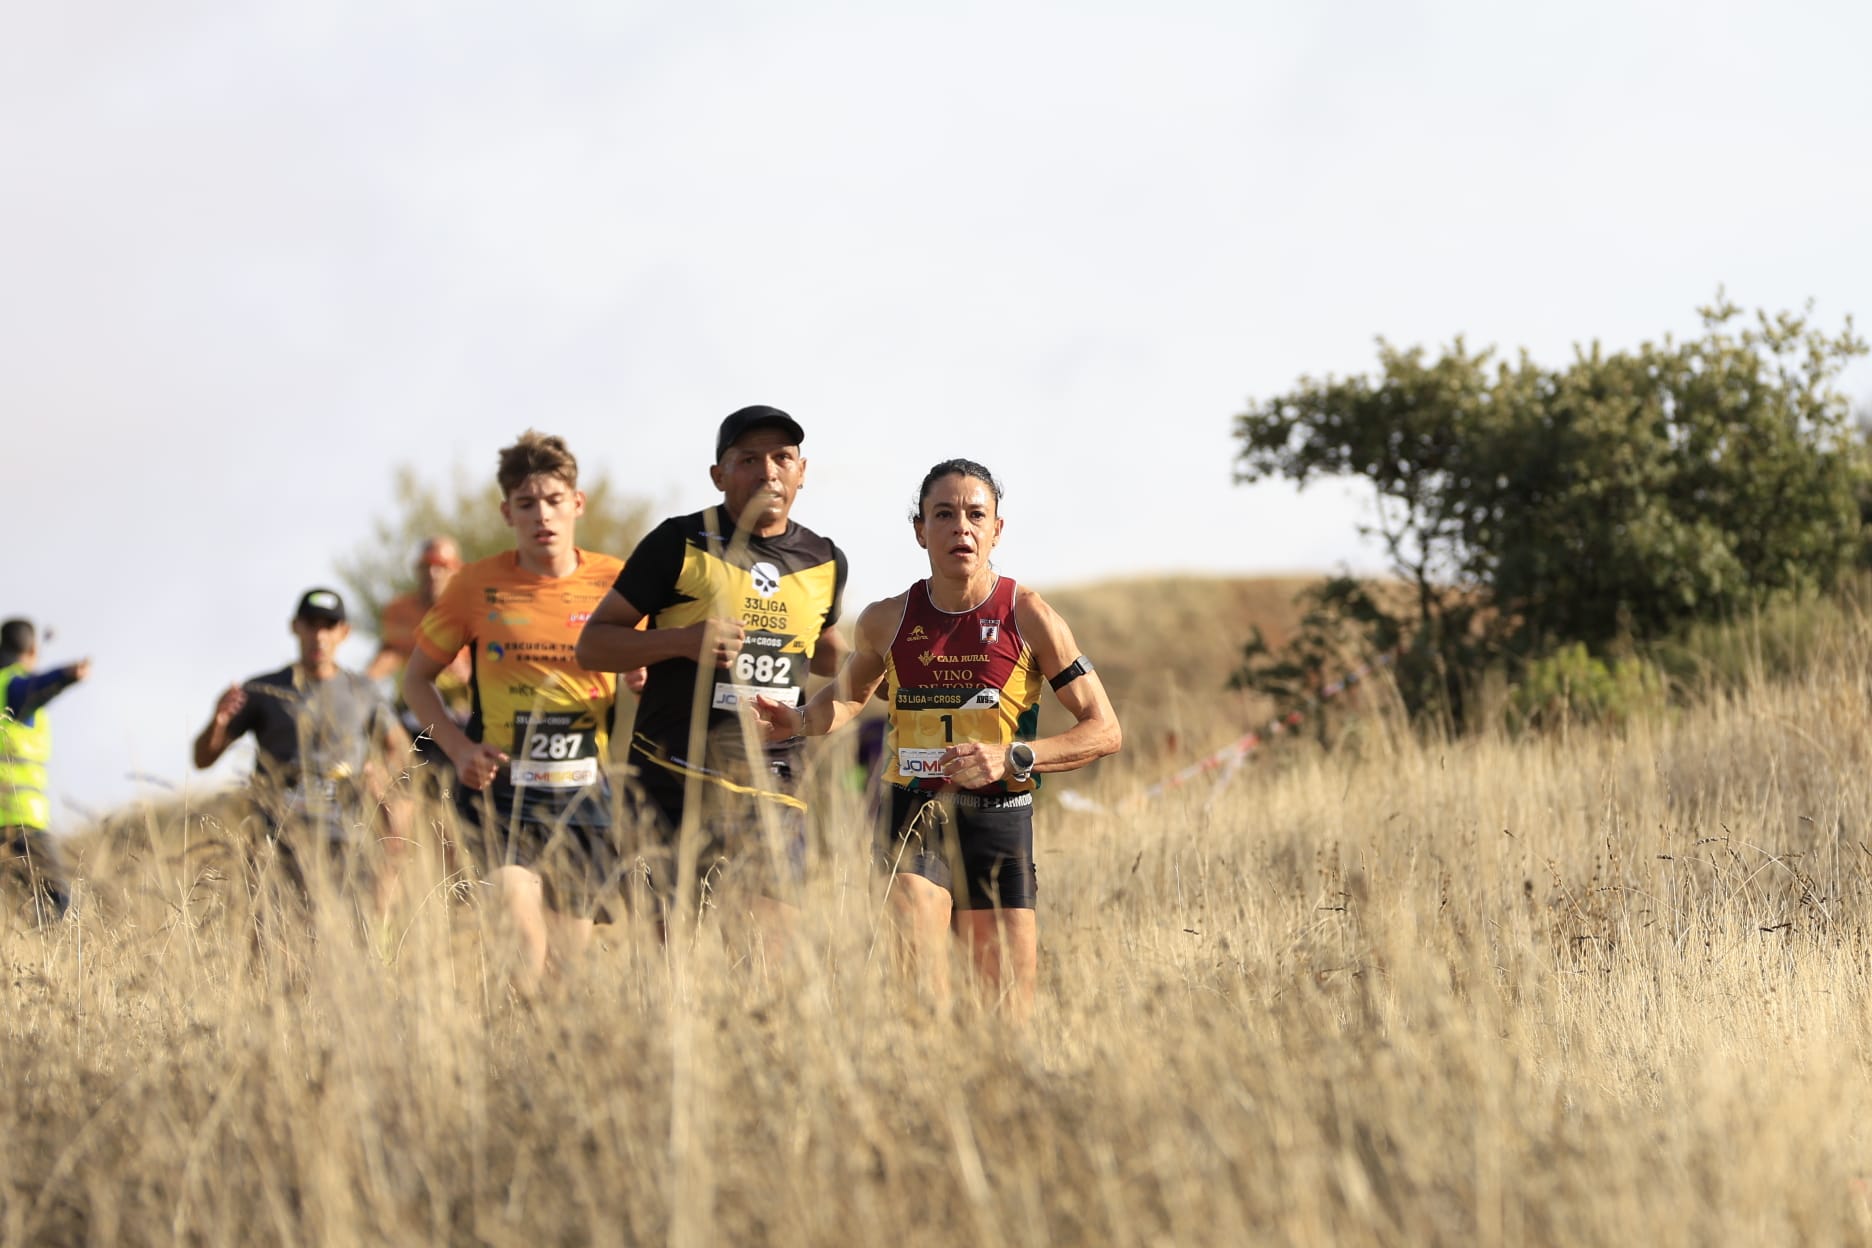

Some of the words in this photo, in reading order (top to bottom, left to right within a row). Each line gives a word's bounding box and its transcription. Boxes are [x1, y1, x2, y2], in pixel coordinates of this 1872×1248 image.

[742, 613, 787, 630] CROSS
[757, 637, 782, 647] CROSS
[961, 654, 990, 662] RURAL
[735, 653, 791, 684] 682
[933, 670, 973, 681] VINO
[898, 695, 907, 703] 33
[908, 695, 927, 704] LIGA
[934, 695, 961, 704] CROSS
[940, 715, 953, 742] 1
[530, 732, 584, 760] 287
